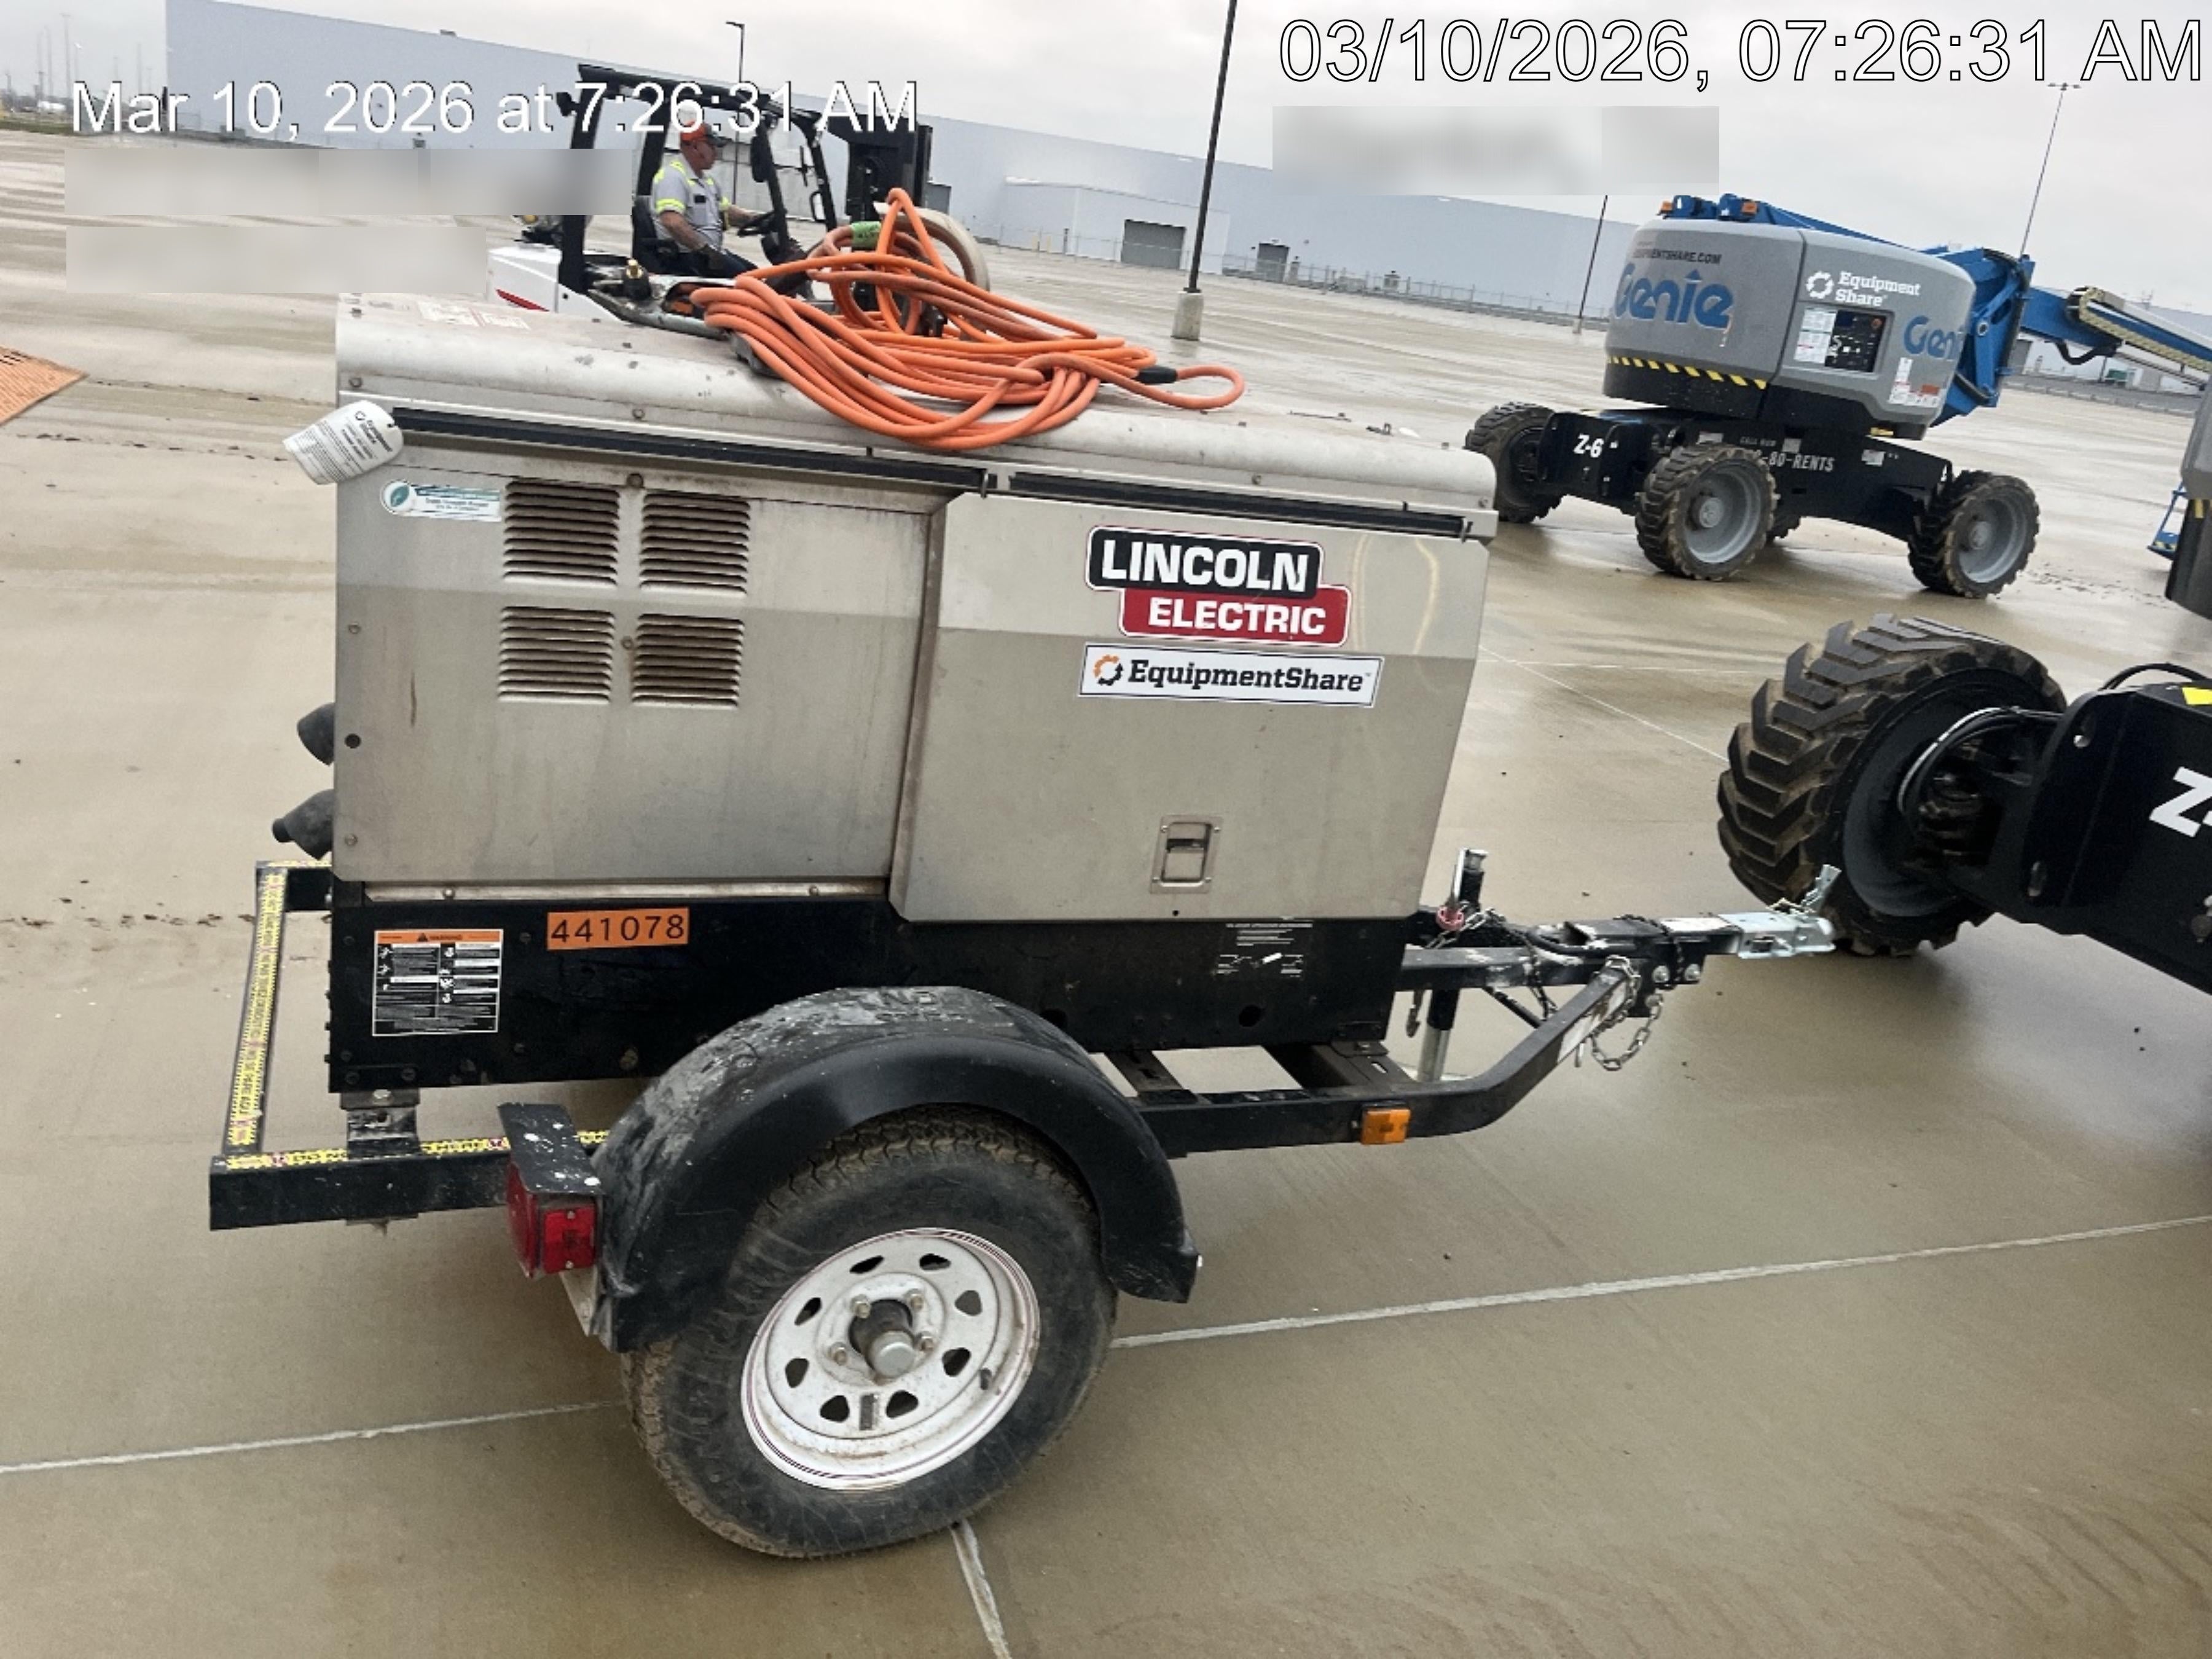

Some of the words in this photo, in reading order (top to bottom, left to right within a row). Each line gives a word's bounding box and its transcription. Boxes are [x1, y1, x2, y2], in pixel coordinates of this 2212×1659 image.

[1835, 288, 1883, 307] Share
[1837, 271, 1921, 296] Equipment
[1760, 450, 1835, 473] -80-RENTS
[1102, 539, 1309, 594] LINCOLN
[1148, 597, 1326, 635] ELECTRIC
[1128, 660, 1363, 691] EquipmentShare
[551, 914, 684, 943] 441078
